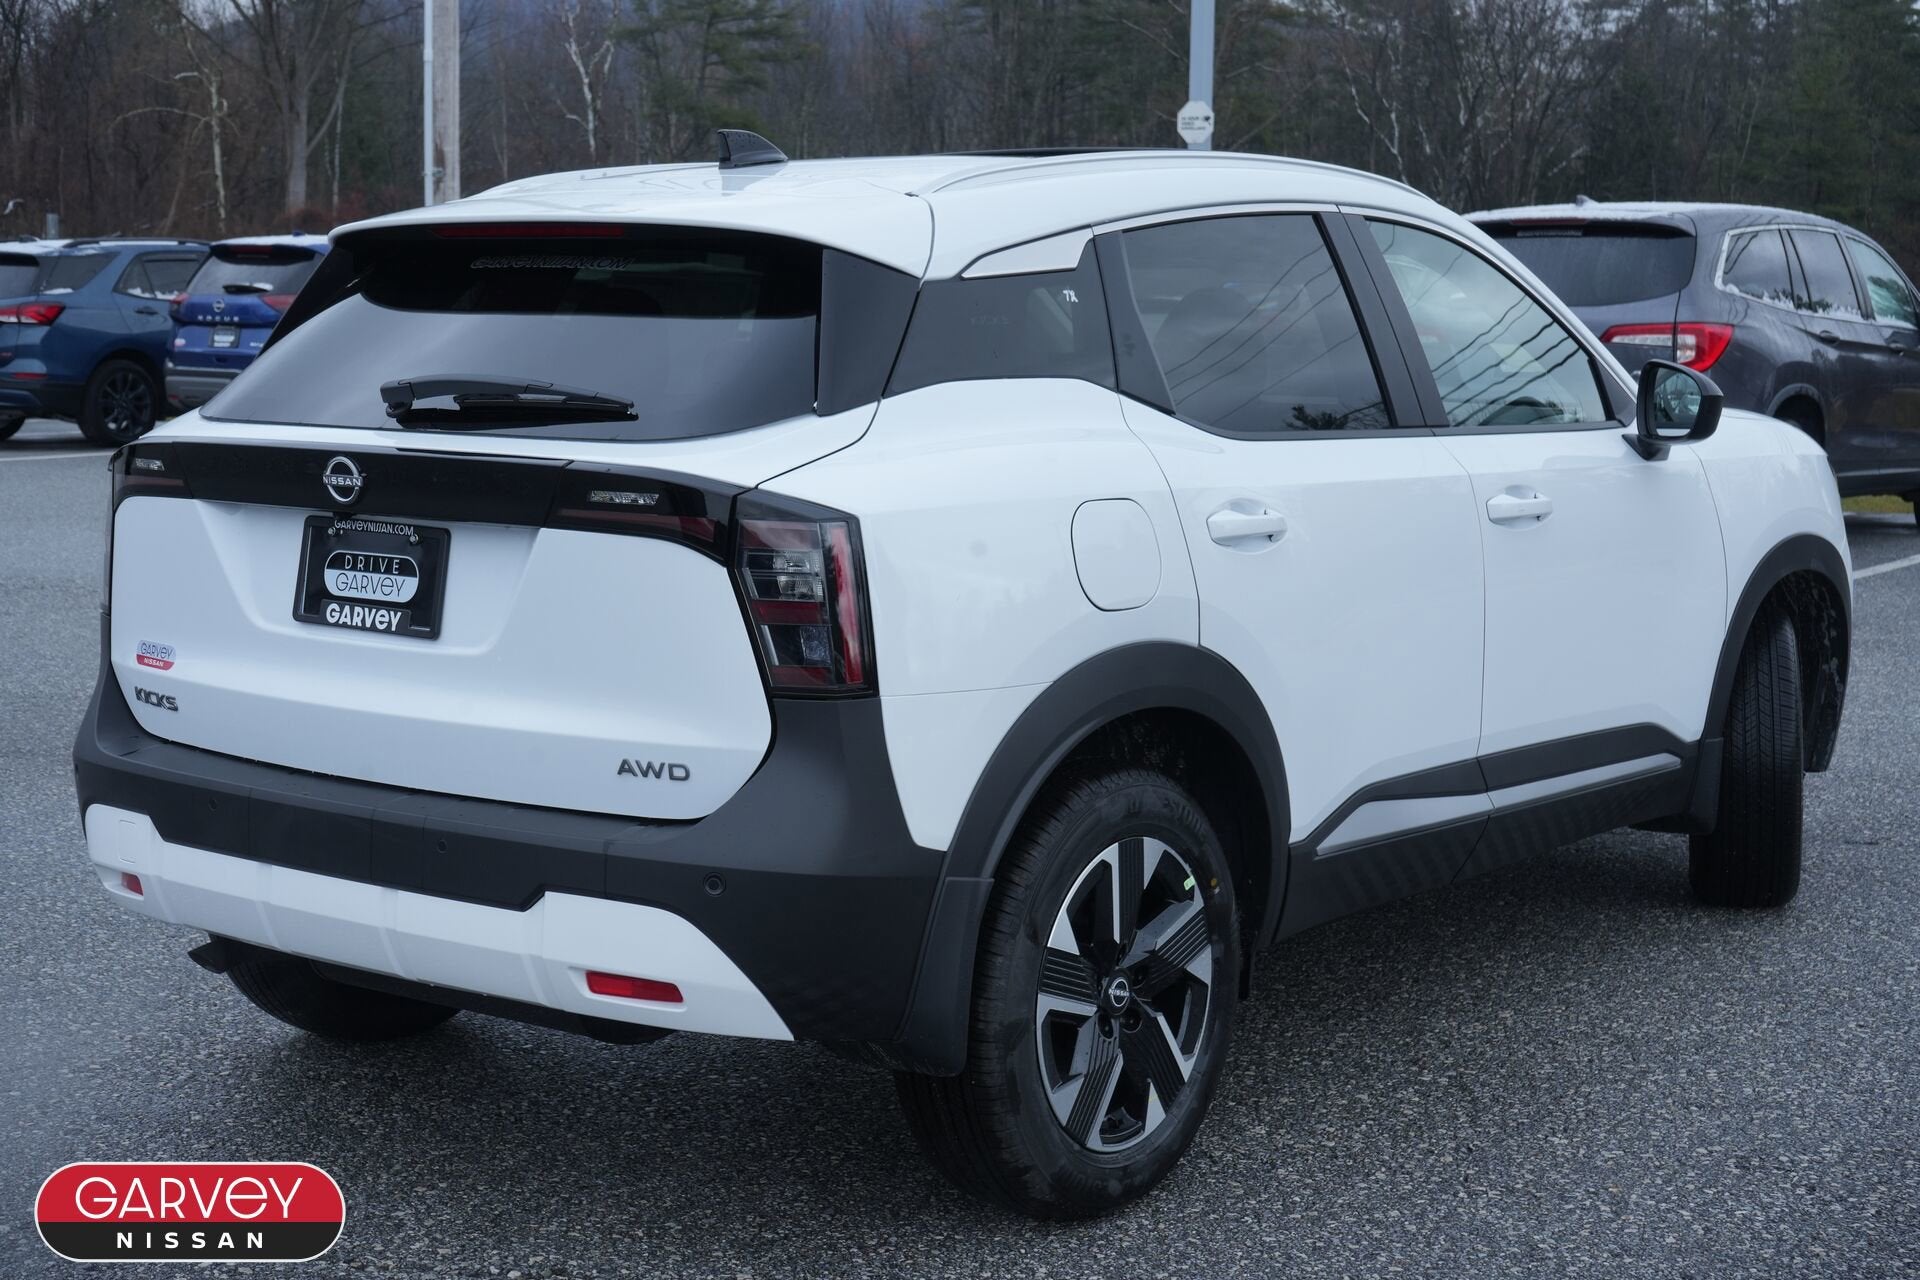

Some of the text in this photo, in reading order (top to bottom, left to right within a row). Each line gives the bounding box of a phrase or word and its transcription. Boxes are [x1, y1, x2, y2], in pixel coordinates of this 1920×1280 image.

[323, 475, 362, 487] NISSAN
[344, 555, 401, 574] DRIVE
[143, 657, 165, 667] NISSAN
[134, 685, 179, 712] KICKS
[617, 758, 691, 781] AWD
